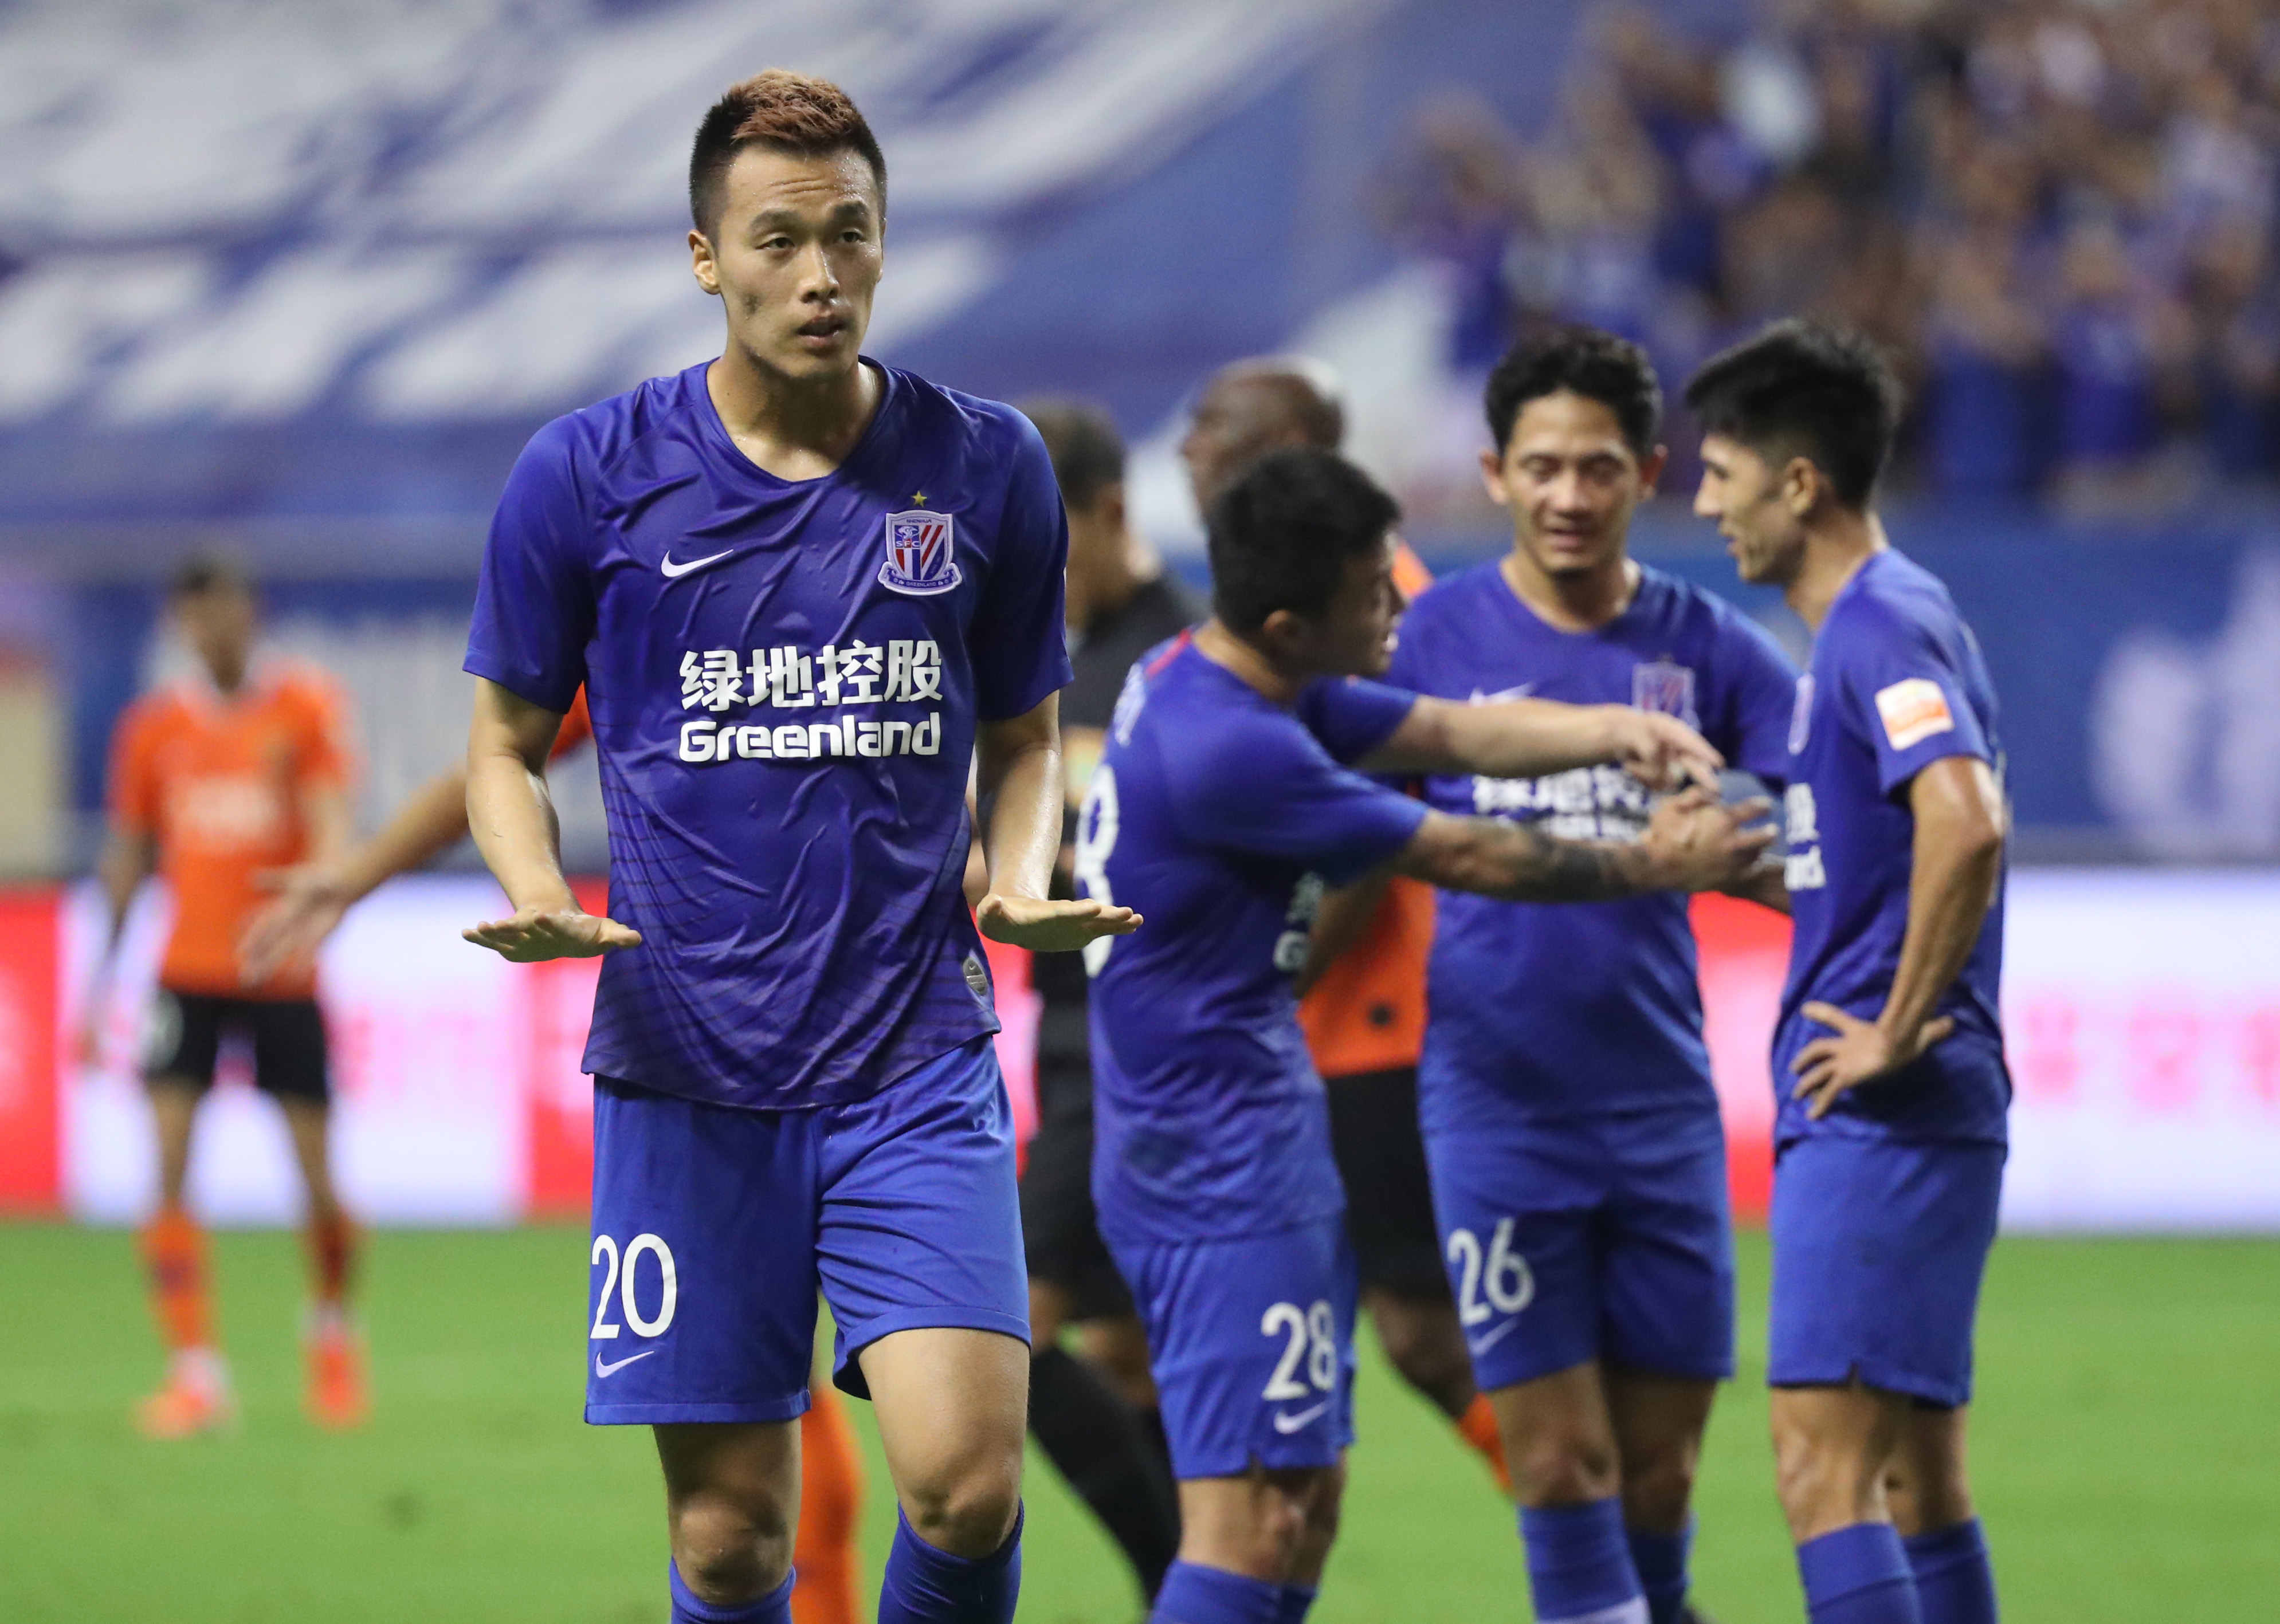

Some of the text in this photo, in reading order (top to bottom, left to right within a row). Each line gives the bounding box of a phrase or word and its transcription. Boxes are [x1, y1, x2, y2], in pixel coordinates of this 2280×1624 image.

[679, 639, 943, 711] 绿地控股
[679, 712, 940, 762] Greenland
[590, 1233, 677, 1338] 20
[1448, 1217, 1535, 1326] 26
[1261, 1299, 1337, 1401] 28
